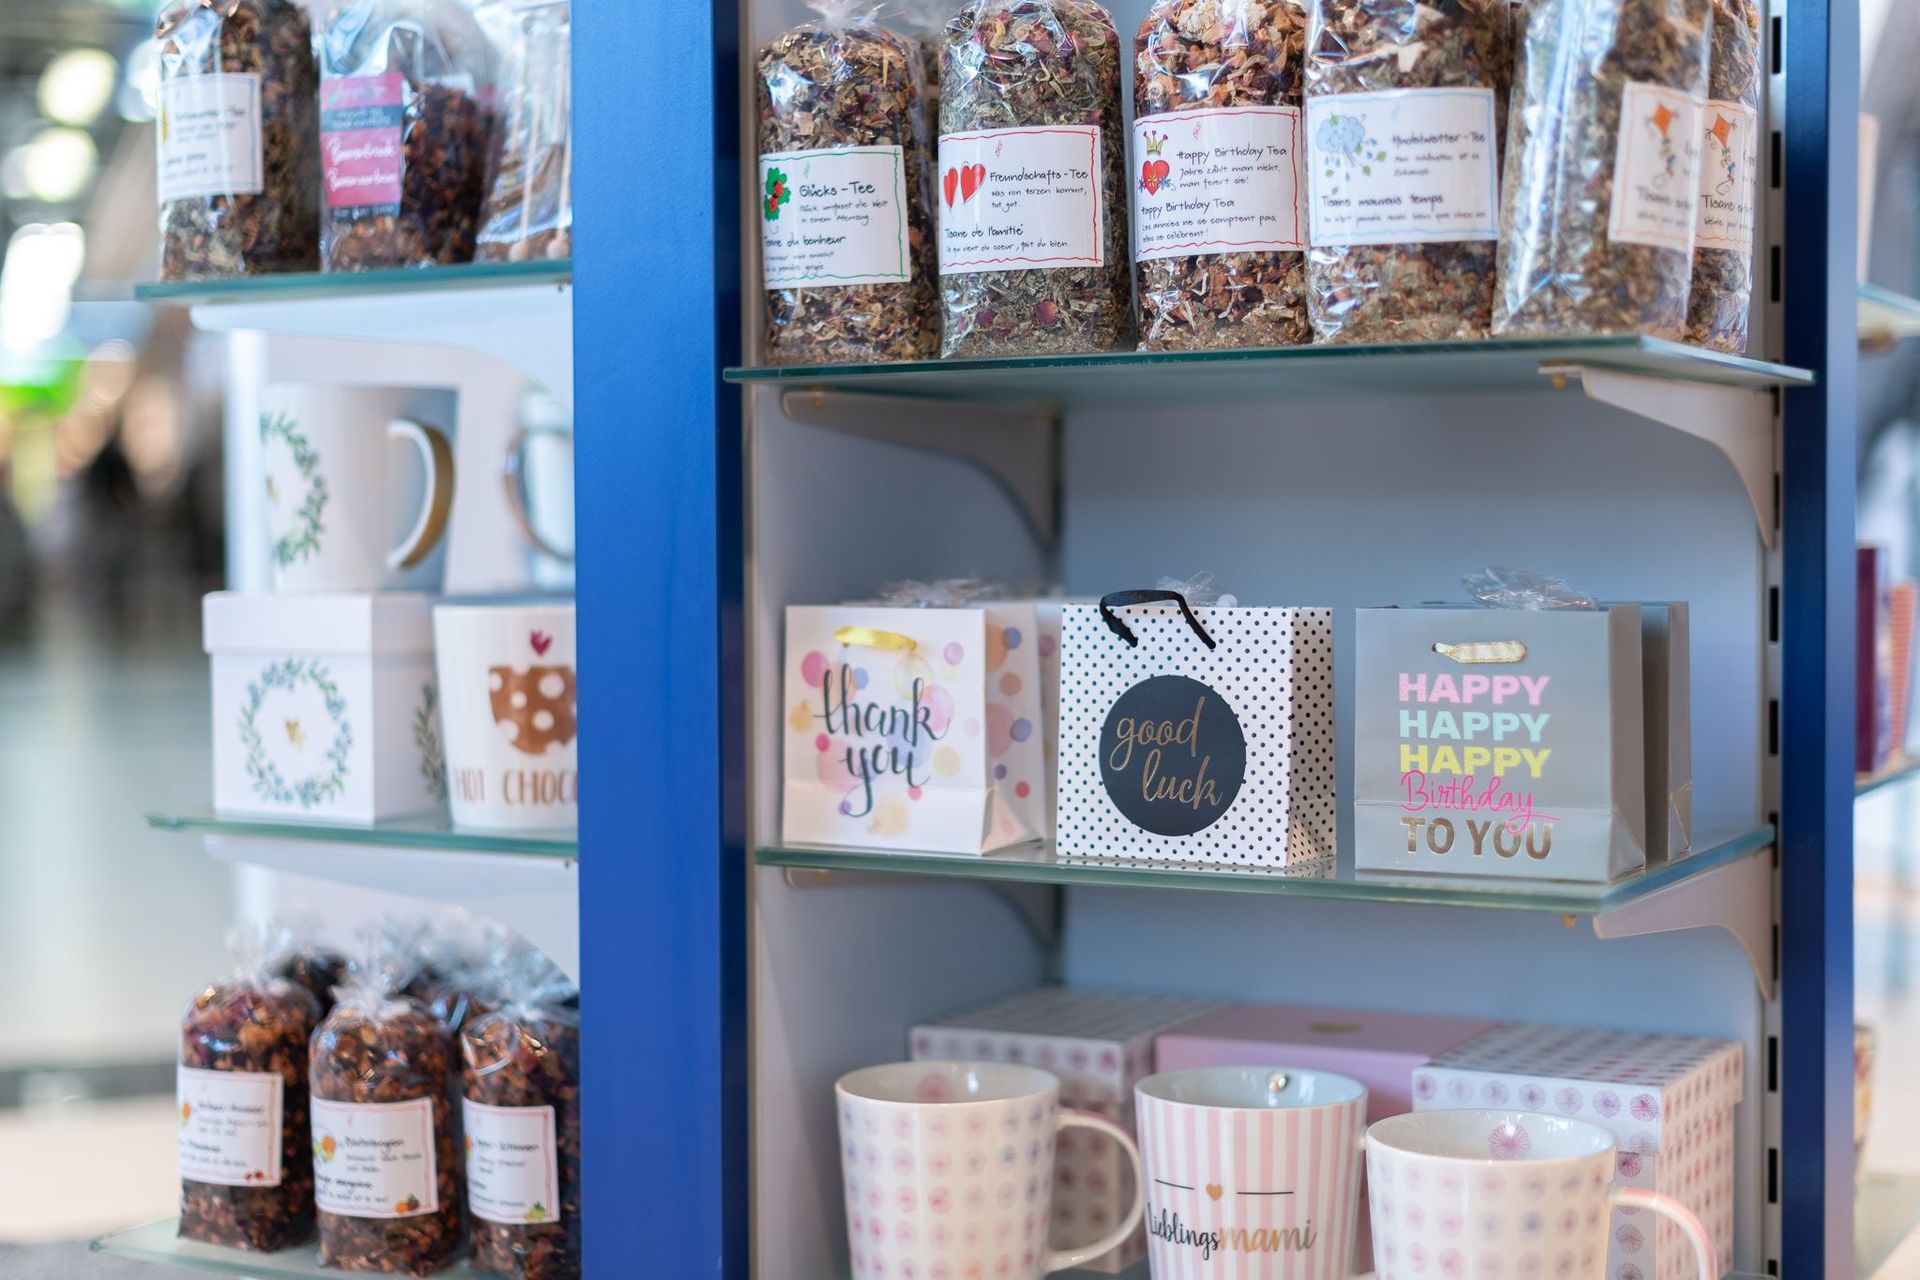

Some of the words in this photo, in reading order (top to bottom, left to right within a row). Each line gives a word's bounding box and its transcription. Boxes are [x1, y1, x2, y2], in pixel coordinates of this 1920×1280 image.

[1176, 151, 1210, 165] Happy
[1214, 142, 1264, 161] Birthday
[1266, 145, 1288, 156] Tea
[1231, 165, 1254, 173] man
[1179, 181, 1200, 189] man
[1165, 196, 1211, 216] Birthday
[1213, 198, 1236, 208] Tea
[1321, 195, 1351, 208] Tisane
[1408, 194, 1444, 213] temps
[1700, 194, 1735, 212] Tisane
[1210, 215, 1256, 228] comptent
[813, 663, 951, 748] thank
[1398, 672, 1551, 706] HAPPY
[1109, 695, 1206, 772] good
[1399, 709, 1551, 743] HAPPY
[1400, 743, 1552, 779] HAPPY
[503, 768, 577, 806] CHOC
[837, 743, 932, 818] you
[1142, 748, 1224, 810] luck
[1400, 769, 1563, 836] Birthday
[1400, 816, 1456, 856] TO
[1465, 818, 1554, 861] YOU
